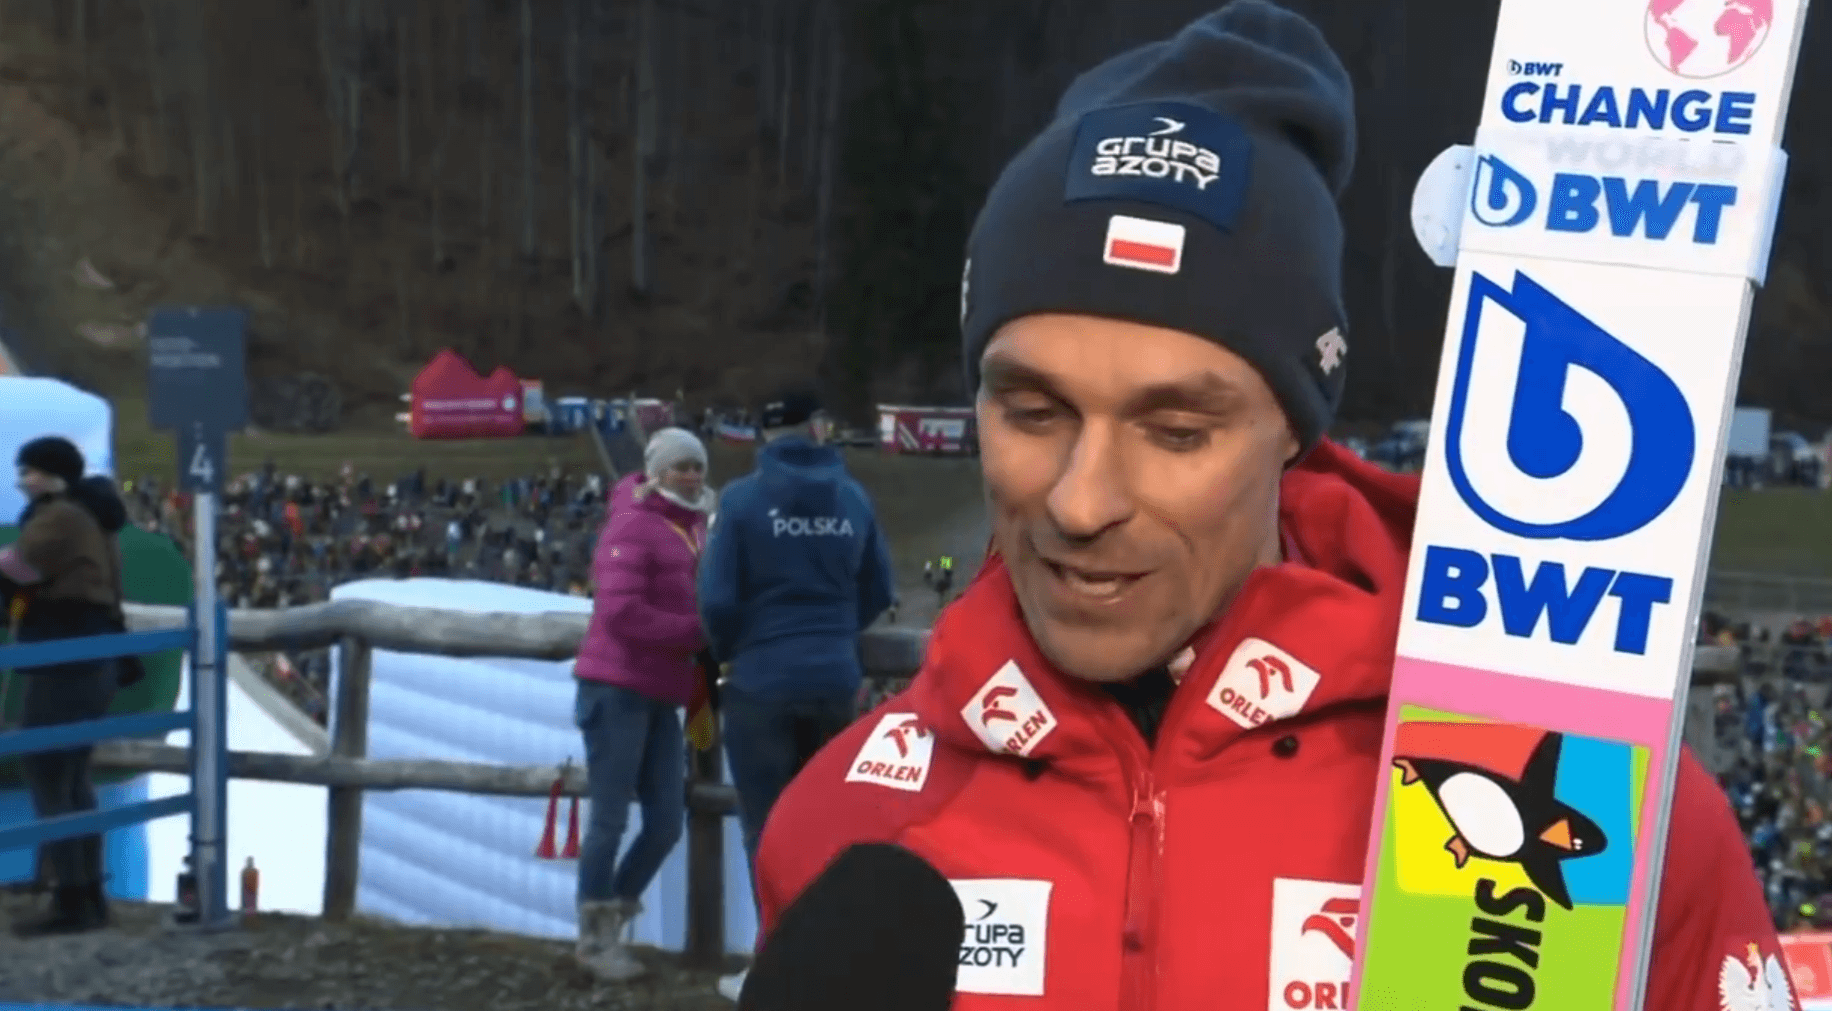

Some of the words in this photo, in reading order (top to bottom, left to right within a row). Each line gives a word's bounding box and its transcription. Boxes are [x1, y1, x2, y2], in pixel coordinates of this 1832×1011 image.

[1523, 62, 1564, 77] BWT
[1501, 82, 1757, 135] CHANGE
[1545, 172, 1738, 244] BWT
[189, 443, 214, 483] 4
[773, 517, 854, 538] POLSKA
[1416, 545, 1673, 655] BWT
[1003, 710, 1049, 754] RLEN
[857, 760, 922, 783] ORLEN
[959, 946, 1025, 968] ZOTY
[1458, 878, 1546, 1011] SKO
